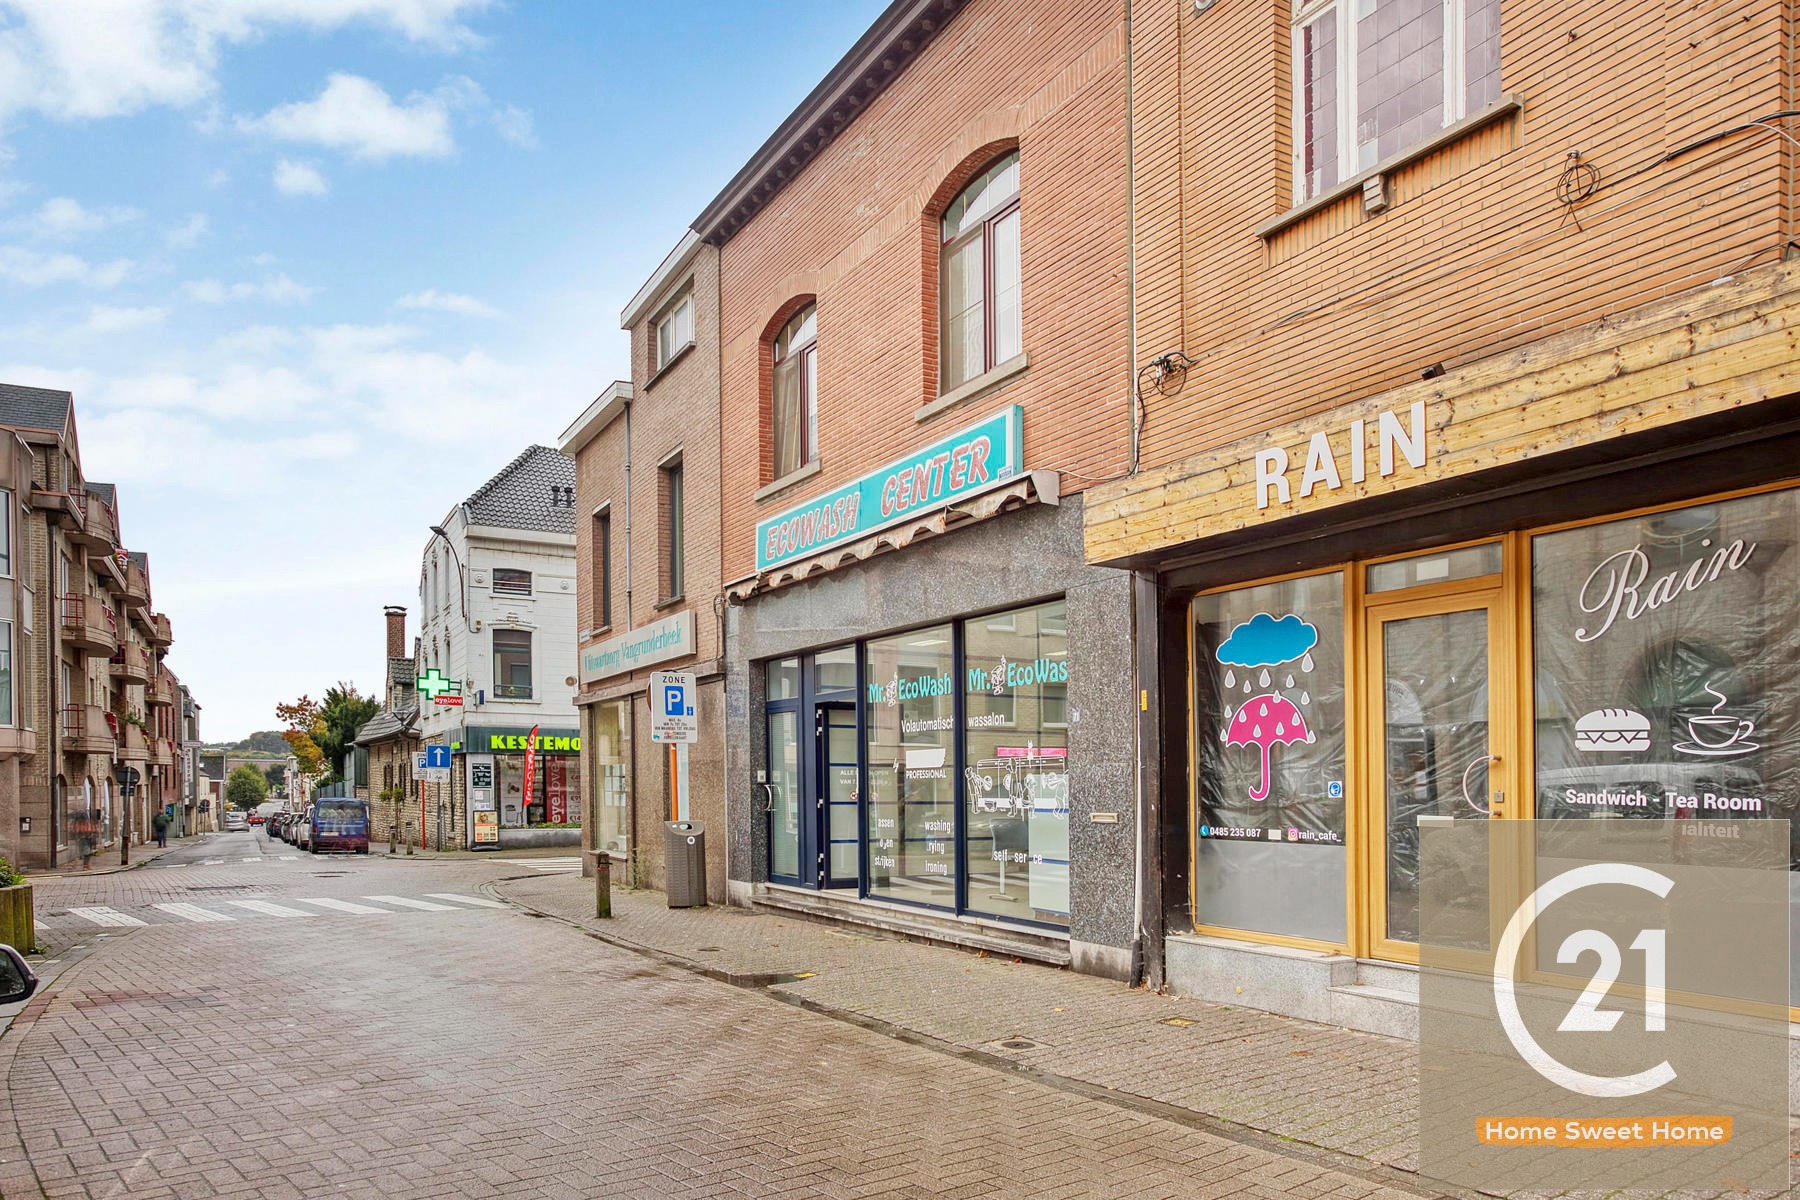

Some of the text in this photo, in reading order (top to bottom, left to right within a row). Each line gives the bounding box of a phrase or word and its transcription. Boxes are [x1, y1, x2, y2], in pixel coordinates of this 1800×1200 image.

[1255, 400, 1427, 509] RAIN
[765, 435, 991, 561] ECOWASH CENTER
[1574, 538, 1757, 642] Rain
[662, 675, 686, 684] ZONE
[868, 672, 952, 704] Mr. EcoWash
[968, 667, 991, 691] Mr.
[667, 690, 682, 712] P
[968, 712, 1005, 727] wassalon
[906, 769, 947, 779] PROFESSIONAL
[549, 762, 565, 824] eyelove
[1565, 789, 1647, 807] Sandwich
[1665, 792, 1698, 808] Tea
[1703, 793, 1762, 811] Room
[924, 819, 951, 834] washing
[1210, 826, 1261, 838] 0485 235 087
[1298, 830, 1342, 842] rain_cafe_
[926, 840, 945, 854] rying
